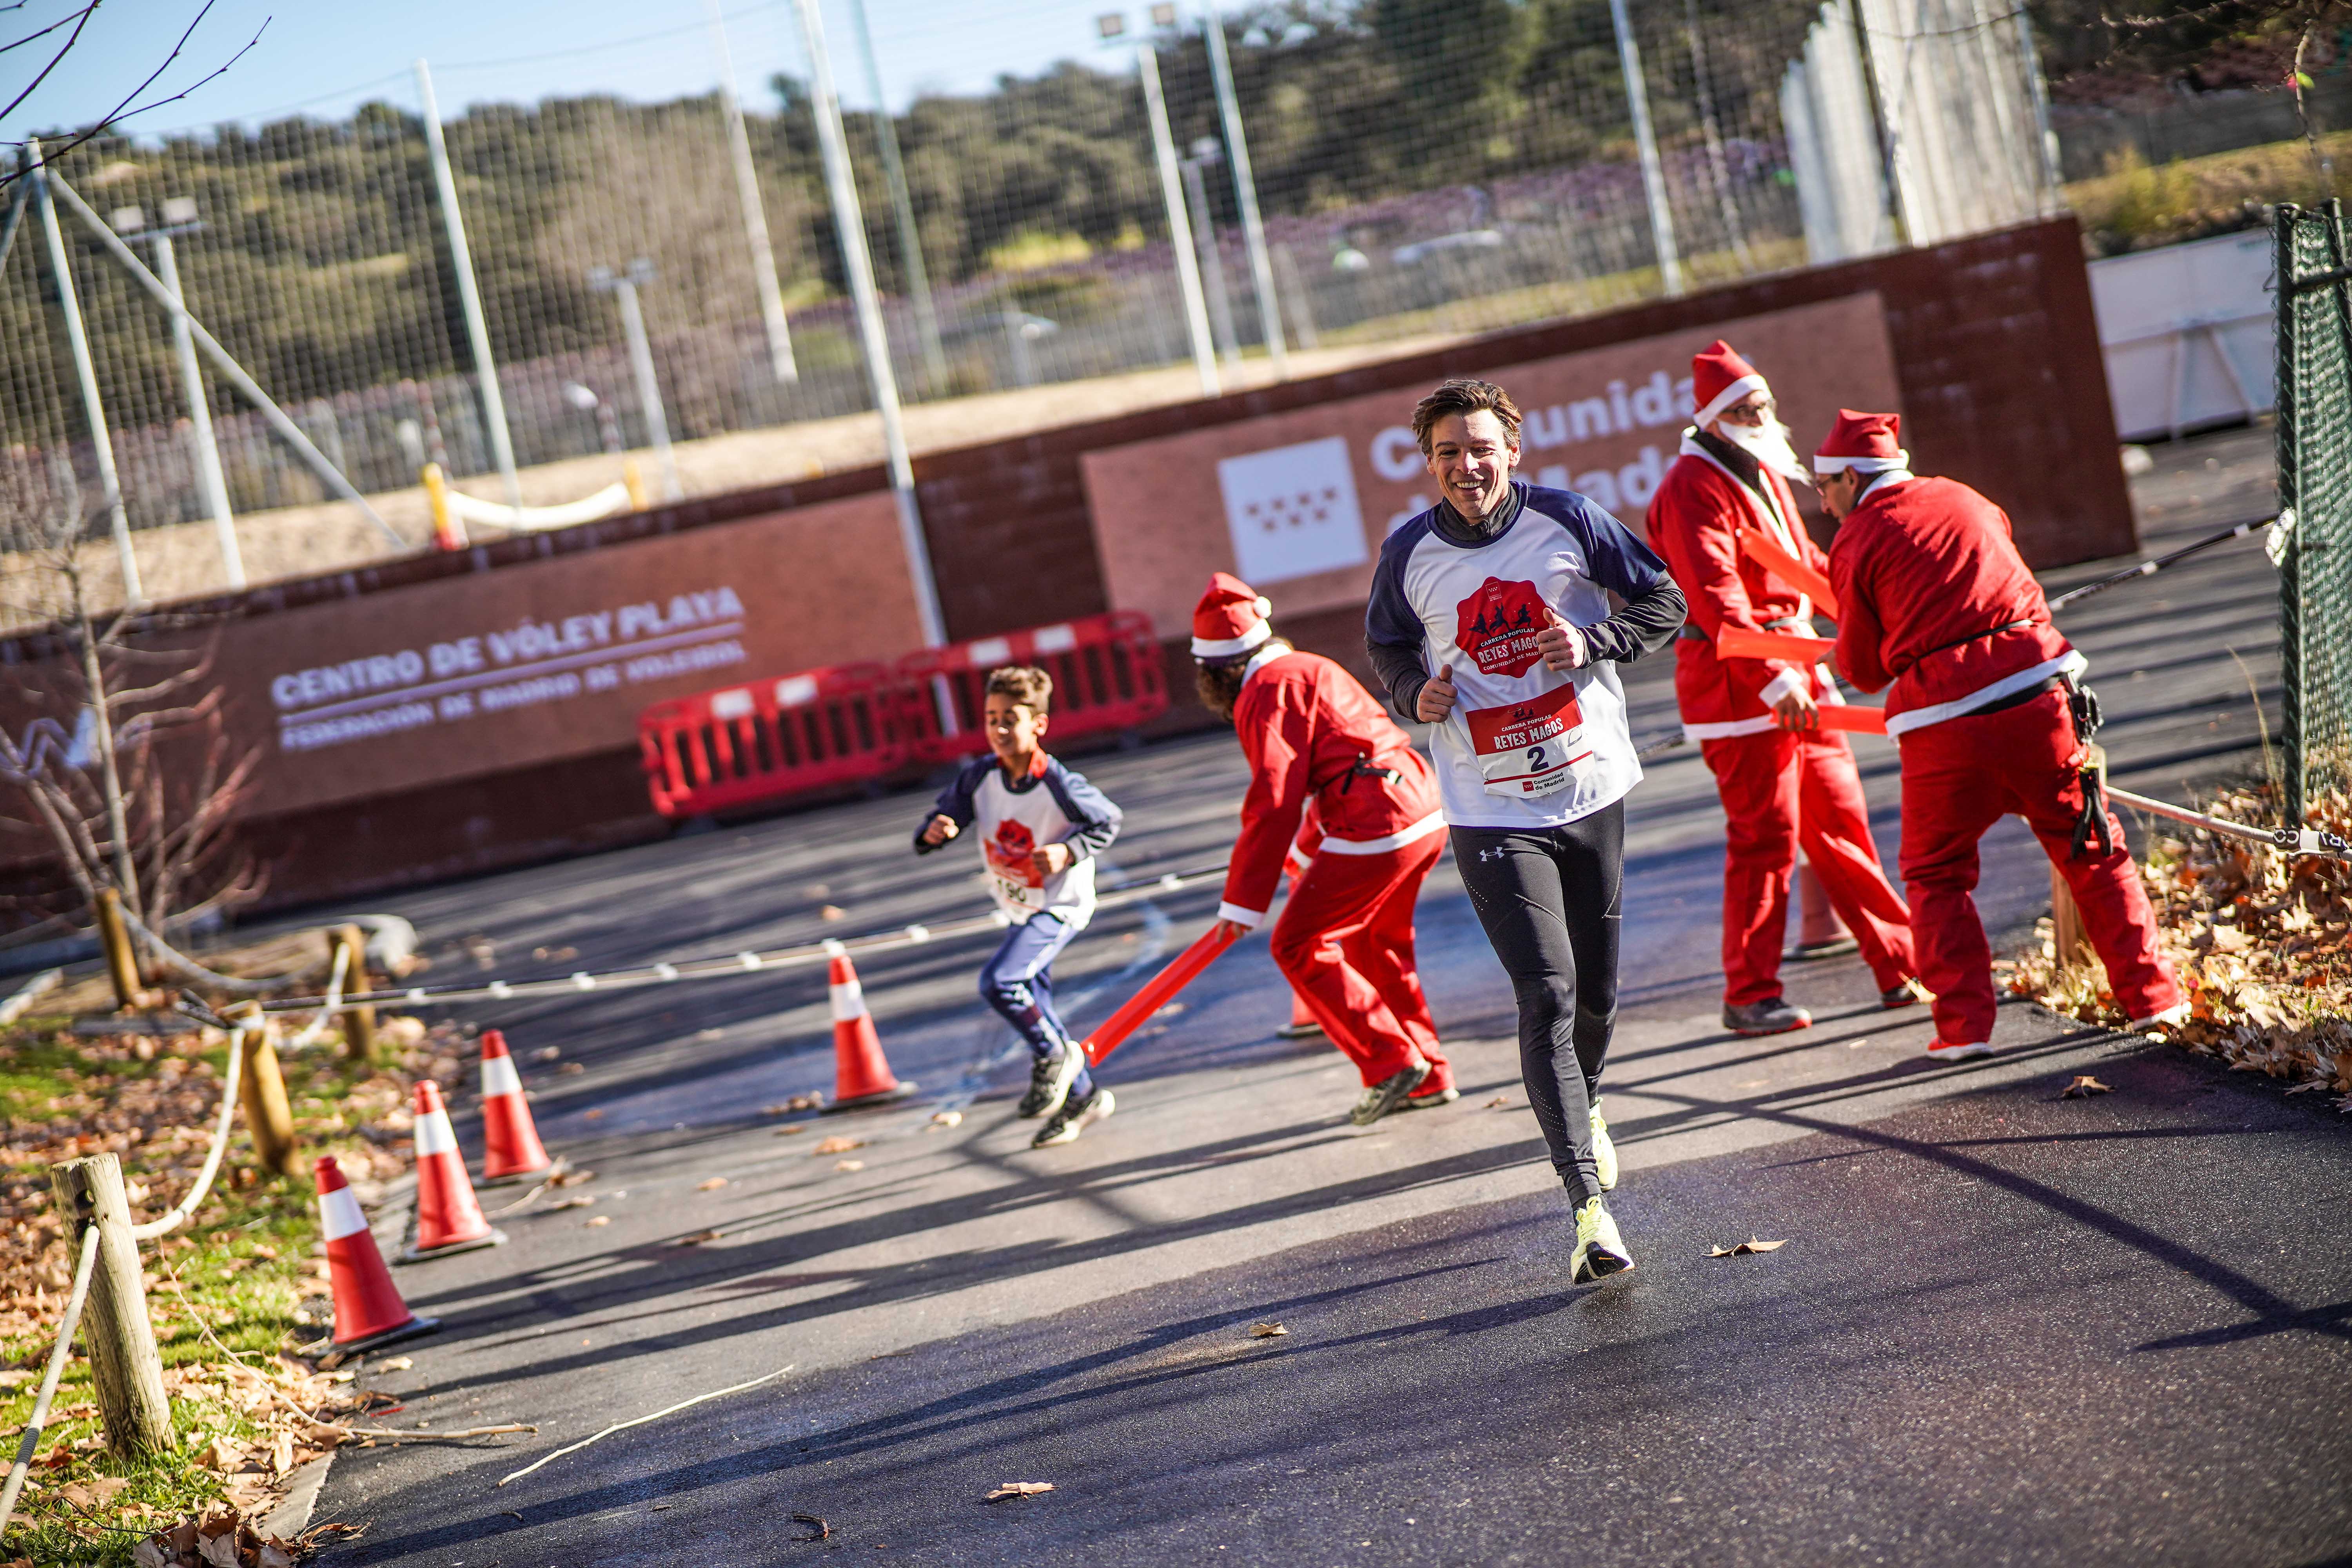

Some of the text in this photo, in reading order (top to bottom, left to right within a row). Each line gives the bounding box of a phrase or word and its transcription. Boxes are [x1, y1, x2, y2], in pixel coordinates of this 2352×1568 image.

[273, 650, 424, 706] CENTRO
[428, 636, 484, 675] DE
[618, 587, 743, 639] PLAYA
[1481, 628, 1535, 647] CARRERA POPULAR
[1477, 636, 1539, 663] REYES MAGO
[1483, 658, 1515, 670] COMUNIDAD
[1501, 714, 1552, 731] CARRERA POPULAR
[1494, 717, 1564, 749] REYES MAGOS
[1527, 746, 1549, 772] 2
[1534, 772, 1563, 784] Comunidad
[1544, 777, 1564, 788] Madrid
